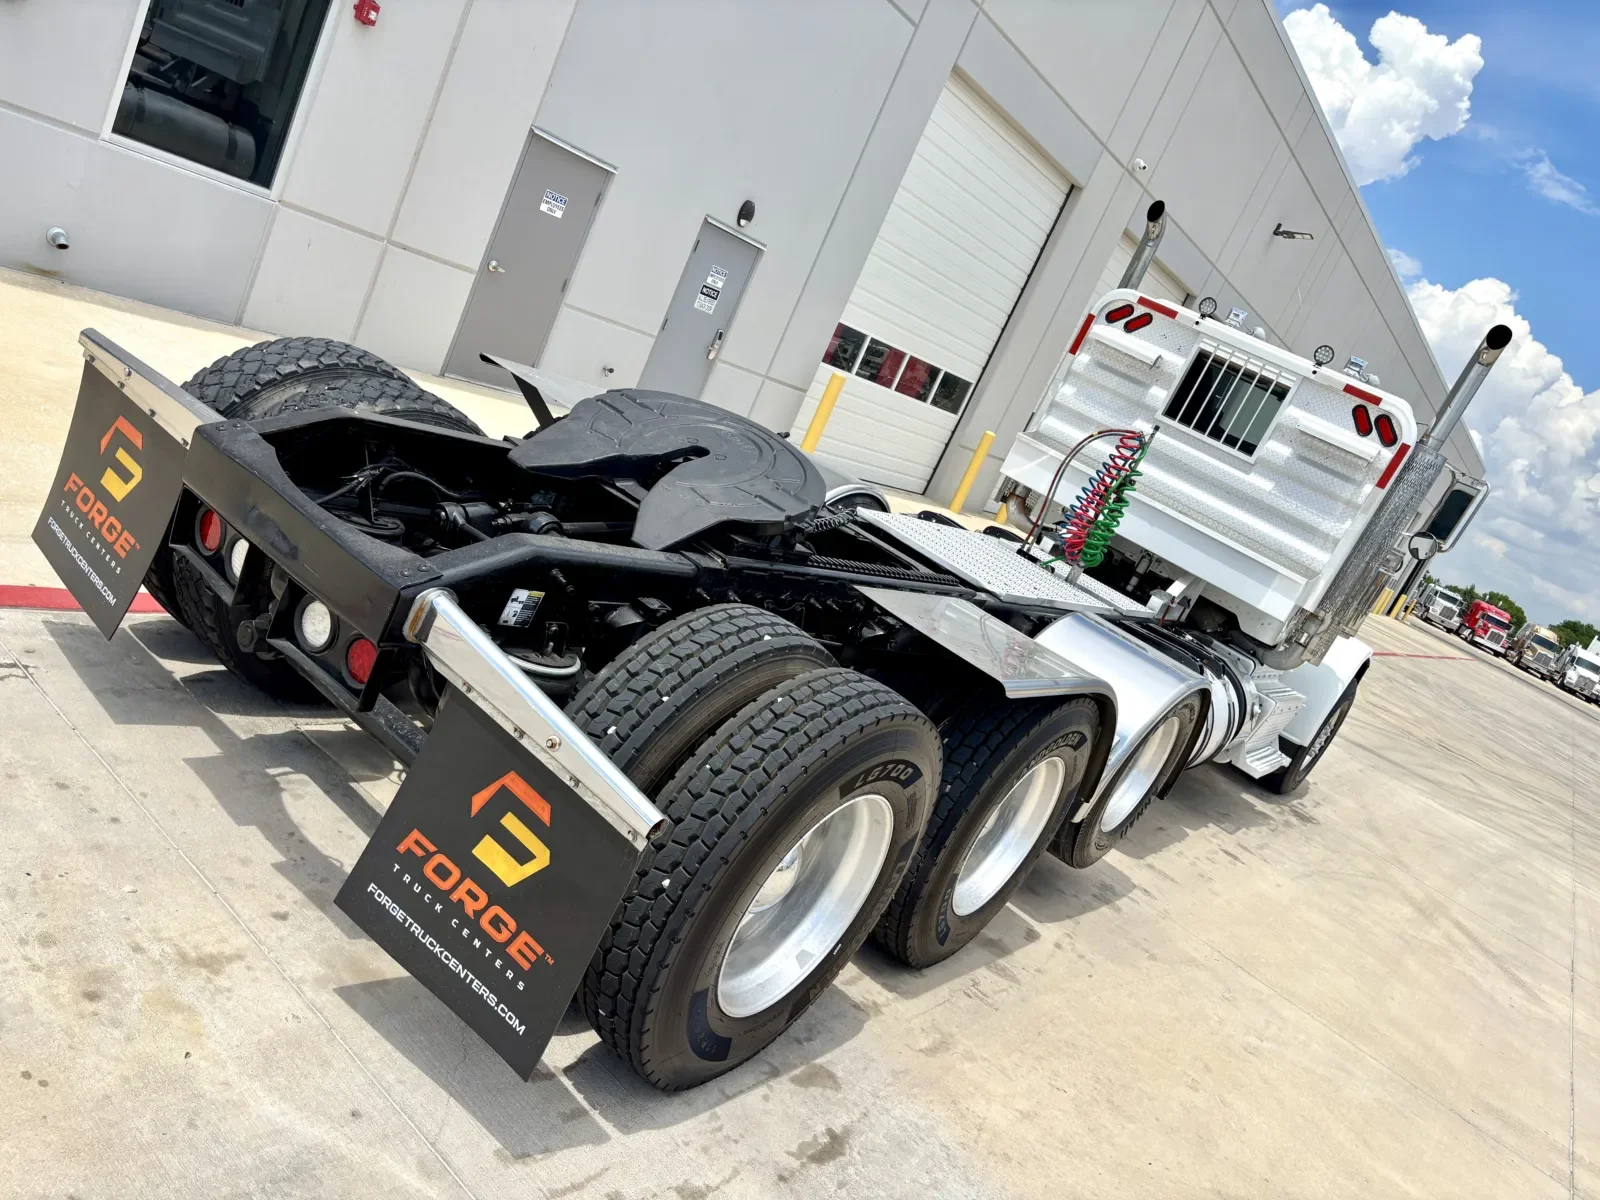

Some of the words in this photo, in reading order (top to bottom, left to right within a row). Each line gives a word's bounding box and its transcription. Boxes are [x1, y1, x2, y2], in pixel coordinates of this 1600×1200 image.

[545, 191, 567, 205] NOTICE
[701, 286, 719, 299] NOTICE
[61, 500, 85, 530] TRUCK
[86, 531, 121, 575] CENTERS
[63, 472, 137, 559] FORGE
[47, 516, 117, 607] FORGETRUCKCENTERS.COM
[392, 863, 443, 914] TRUCK
[451, 918, 525, 991] CENTERS
[395, 828, 545, 972] FORGE
[367, 882, 526, 1036] FORGETRUCKCENTERS.COM
